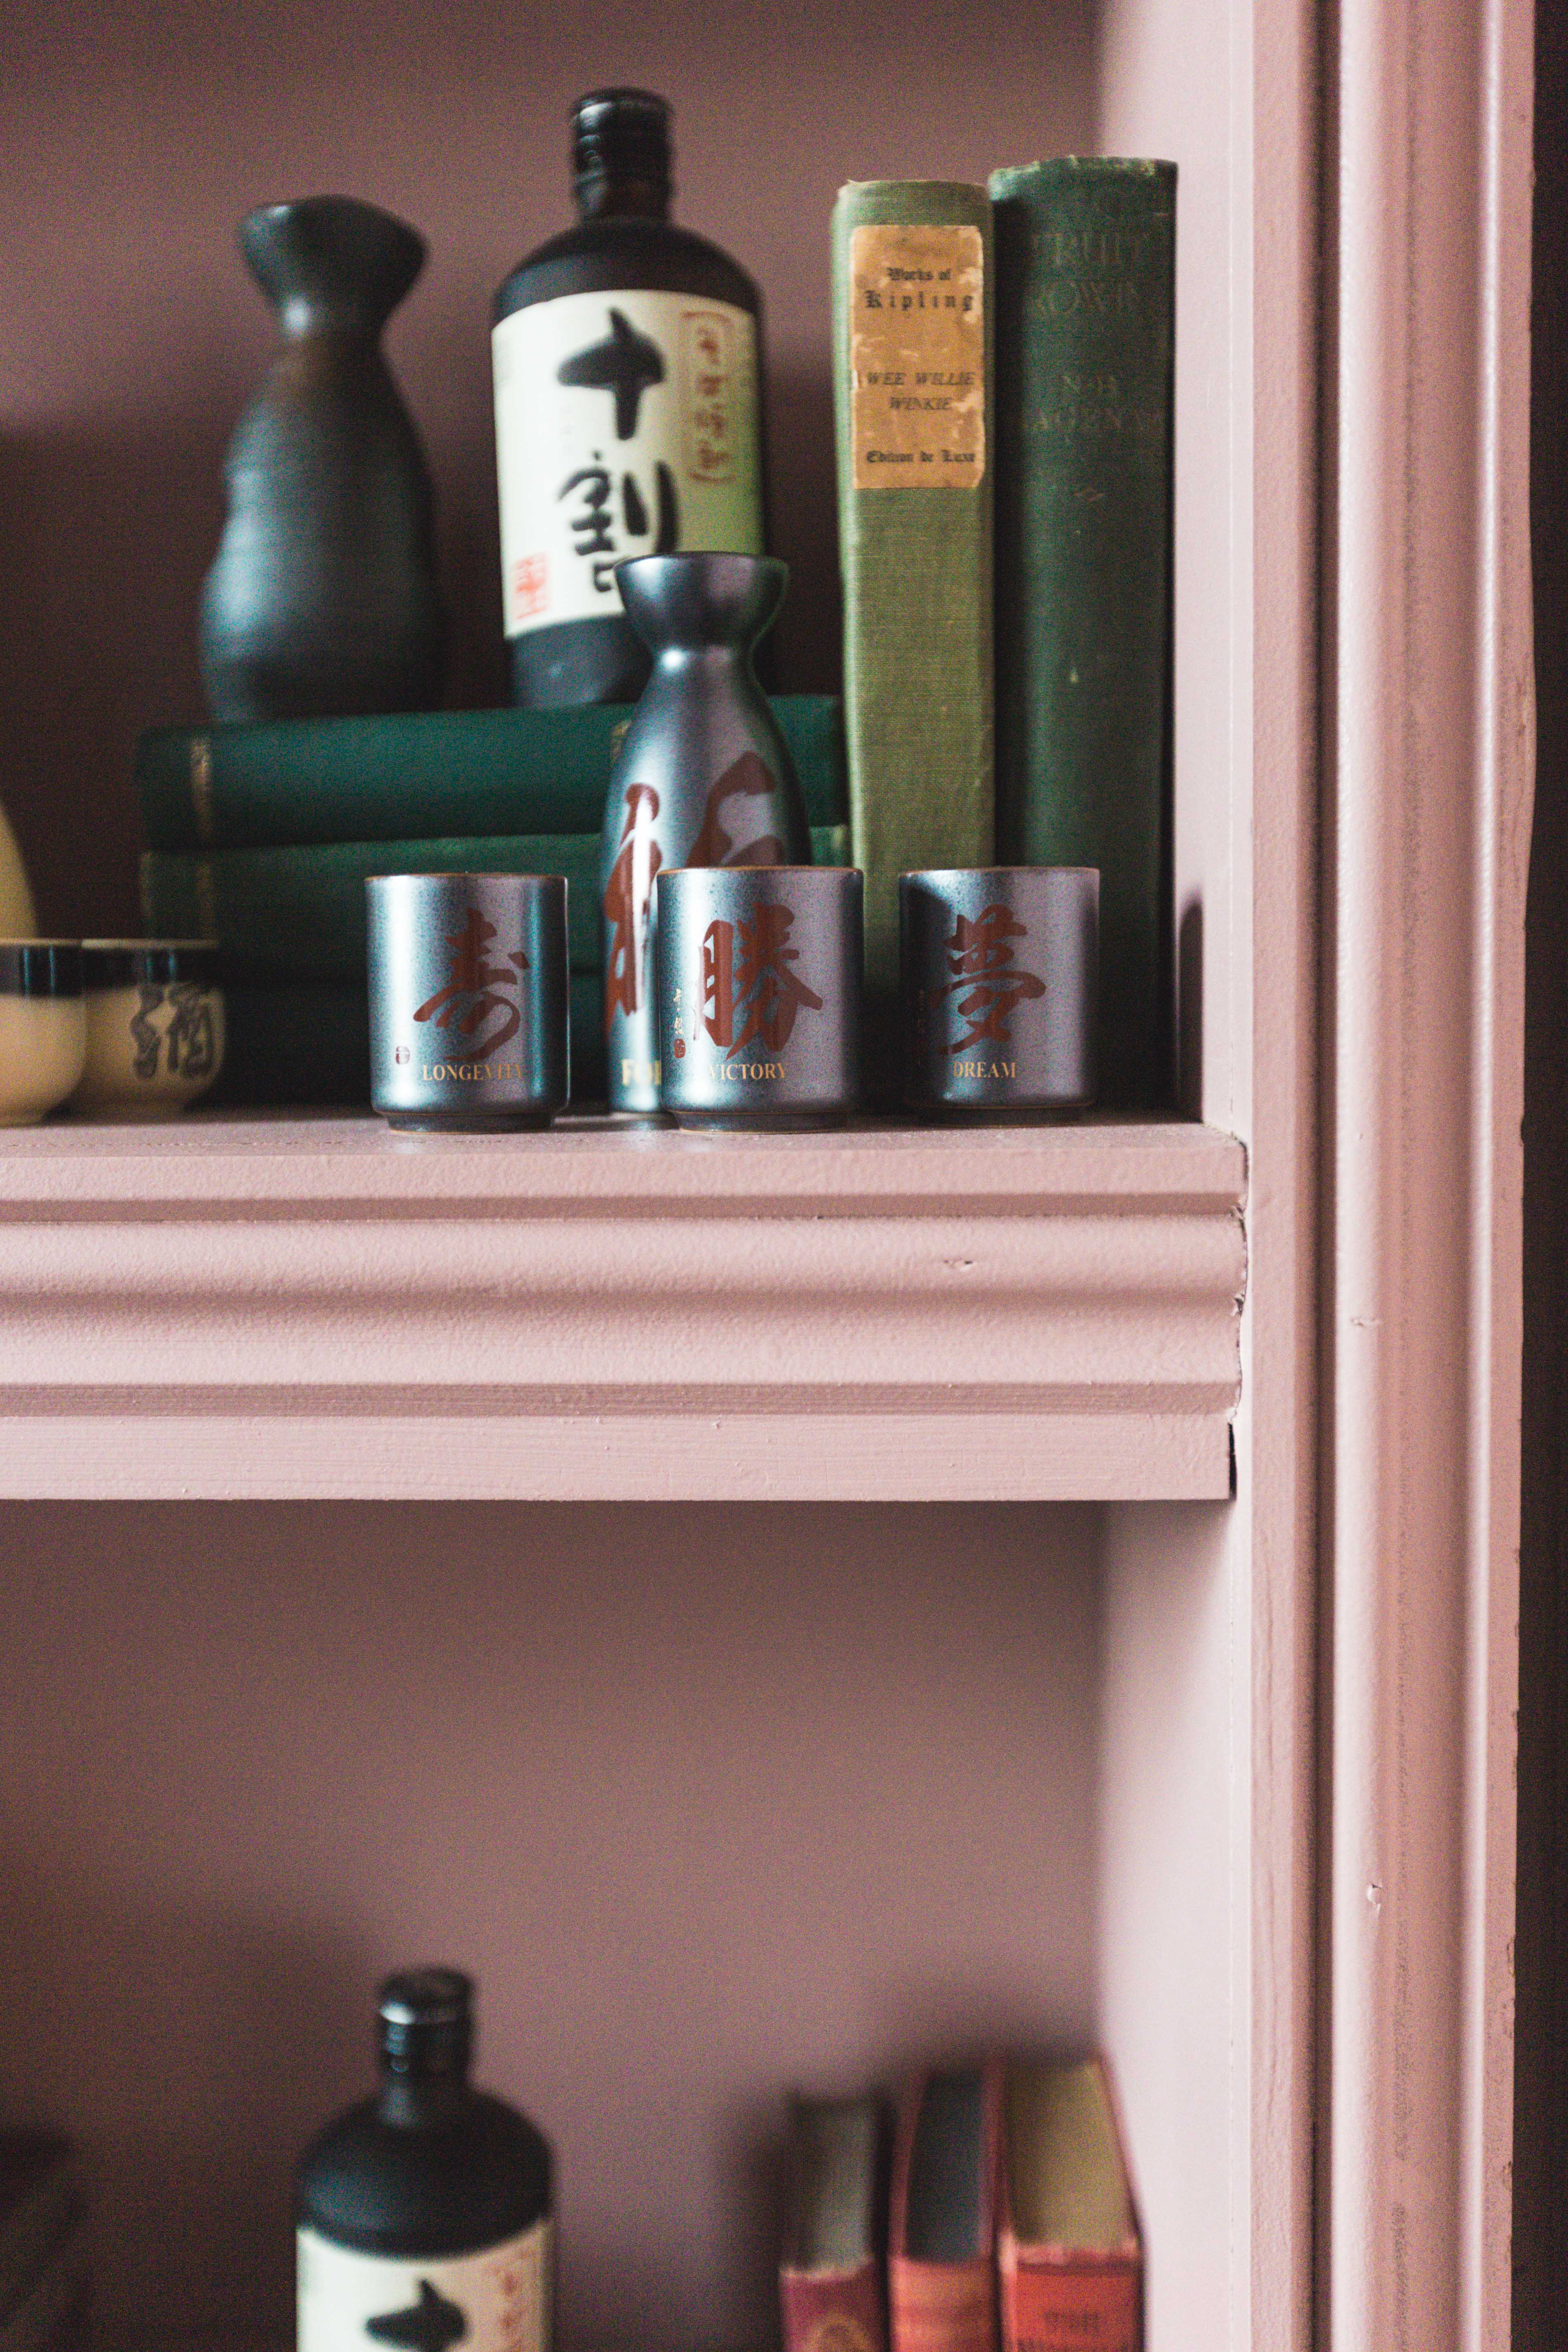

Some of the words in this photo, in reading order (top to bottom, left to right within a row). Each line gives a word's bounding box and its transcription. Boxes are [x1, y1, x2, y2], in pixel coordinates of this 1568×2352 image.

[864, 290, 974, 312] Kipling
[867, 371, 907, 386] WEE
[915, 371, 975, 386] WILLIE
[889, 396, 953, 411] WINKIE
[422, 1064, 523, 1082] LONGEVITY
[709, 1063, 786, 1081] VICTORY
[952, 1061, 1016, 1079] DREAM
